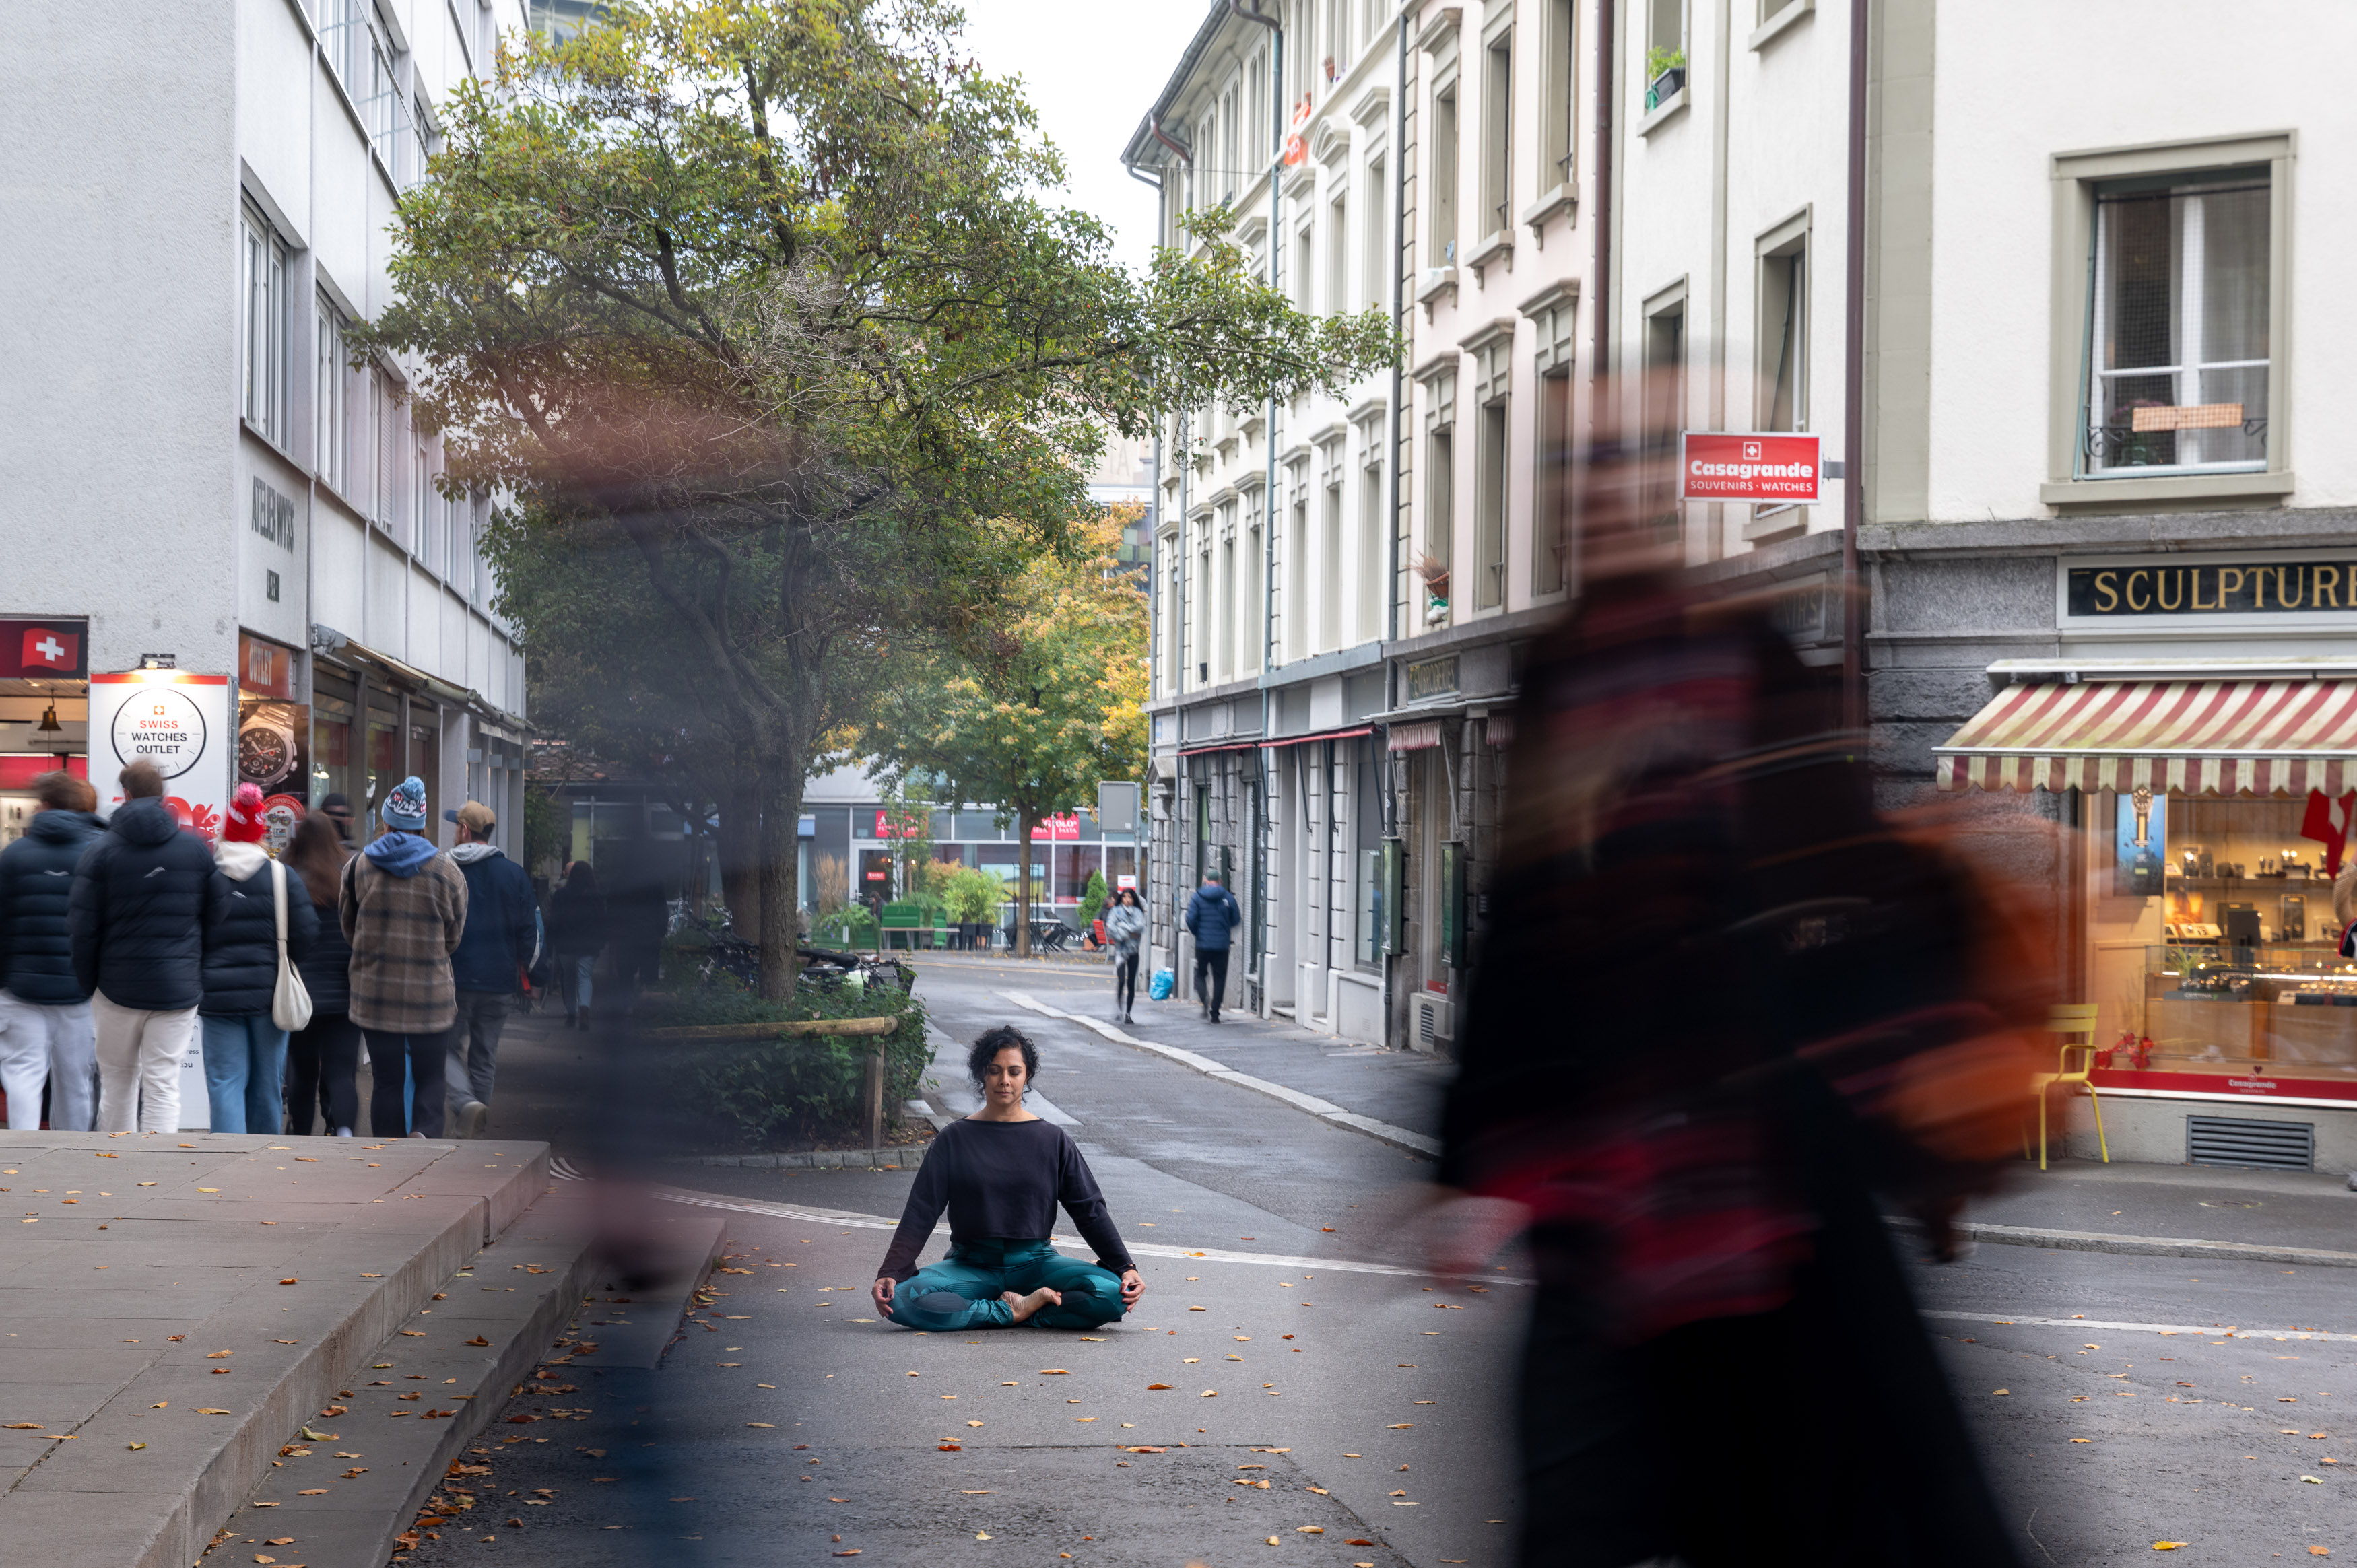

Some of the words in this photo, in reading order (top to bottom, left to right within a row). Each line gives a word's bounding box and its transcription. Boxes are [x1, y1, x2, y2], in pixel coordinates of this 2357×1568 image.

[1690, 459, 1814, 479] Casagrande
[1690, 480, 1754, 491] SOUVENIRS
[1761, 482, 1813, 492] WATCHES
[251, 475, 276, 543] ATELIER
[277, 491, 294, 555] WYSS
[248, 642, 273, 687] OUTLET
[139, 720, 178, 729] SWISS
[131, 732, 187, 741] WATCHES
[136, 745, 180, 754] OUTLET
[2228, 1079, 2277, 1089] Casagrande
